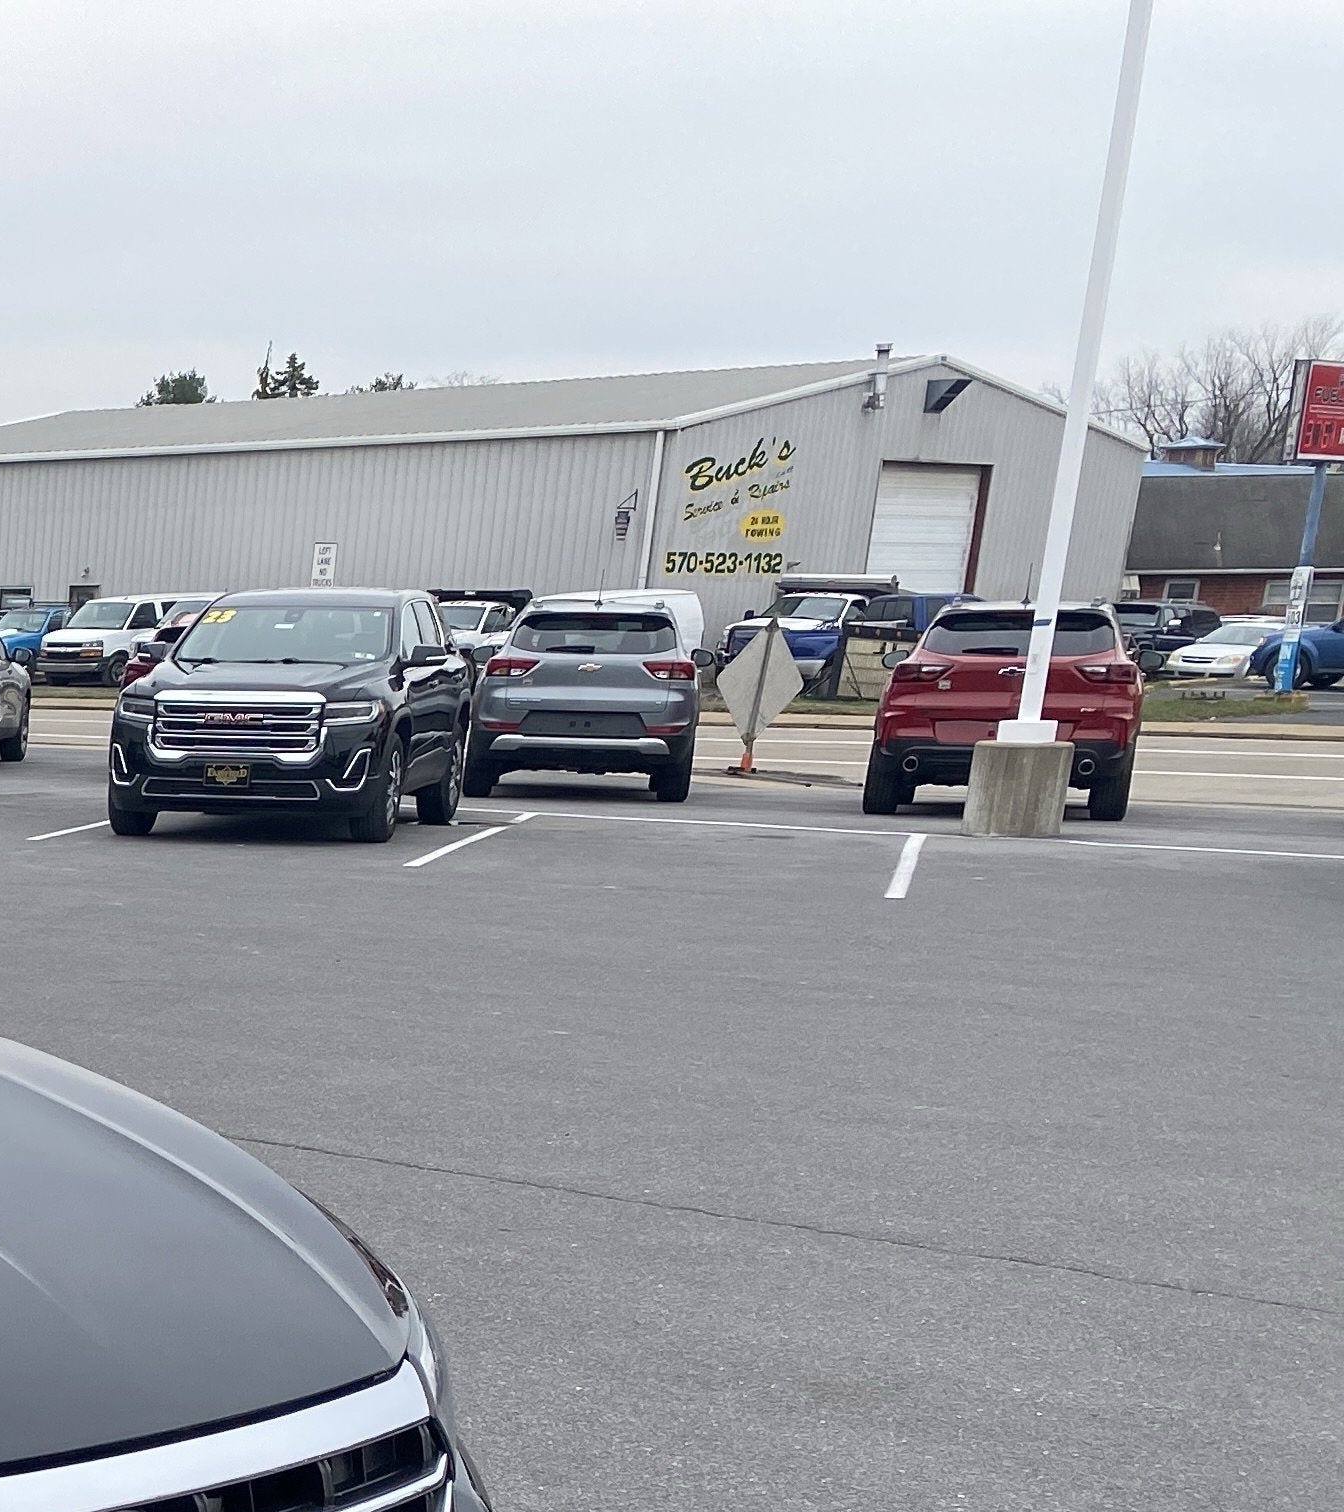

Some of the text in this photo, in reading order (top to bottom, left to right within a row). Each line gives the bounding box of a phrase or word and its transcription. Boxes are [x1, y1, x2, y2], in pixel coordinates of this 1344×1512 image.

[685, 437, 796, 491] Buck's
[745, 528, 781, 538] TOWING
[665, 552, 783, 574] 570-523-1132
[205, 712, 264, 726] GMC
